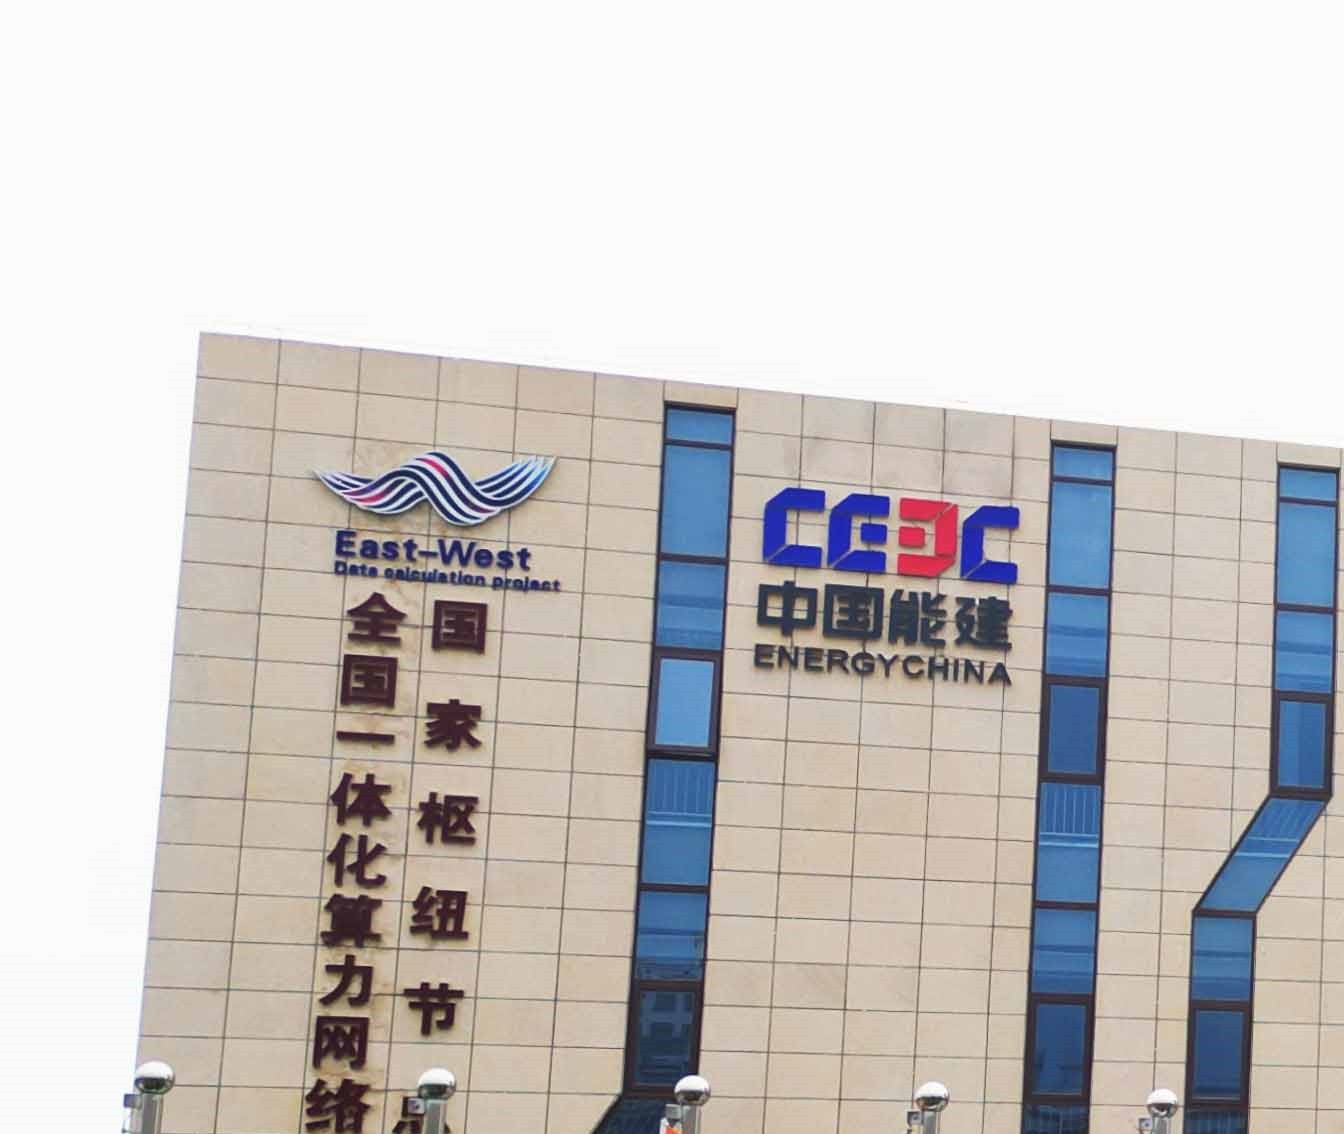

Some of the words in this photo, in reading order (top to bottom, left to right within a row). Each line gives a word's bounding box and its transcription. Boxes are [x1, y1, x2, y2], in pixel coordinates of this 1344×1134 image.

[335, 529, 532, 572] East-West
[334, 560, 379, 578] Data
[384, 566, 486, 587] calculation
[492, 575, 562, 593] project
[757, 580, 1014, 652] 中国能建
[754, 643, 1013, 687] ENERGYCHINA
[305, 591, 406, 1134] 全国一体化算力网络
